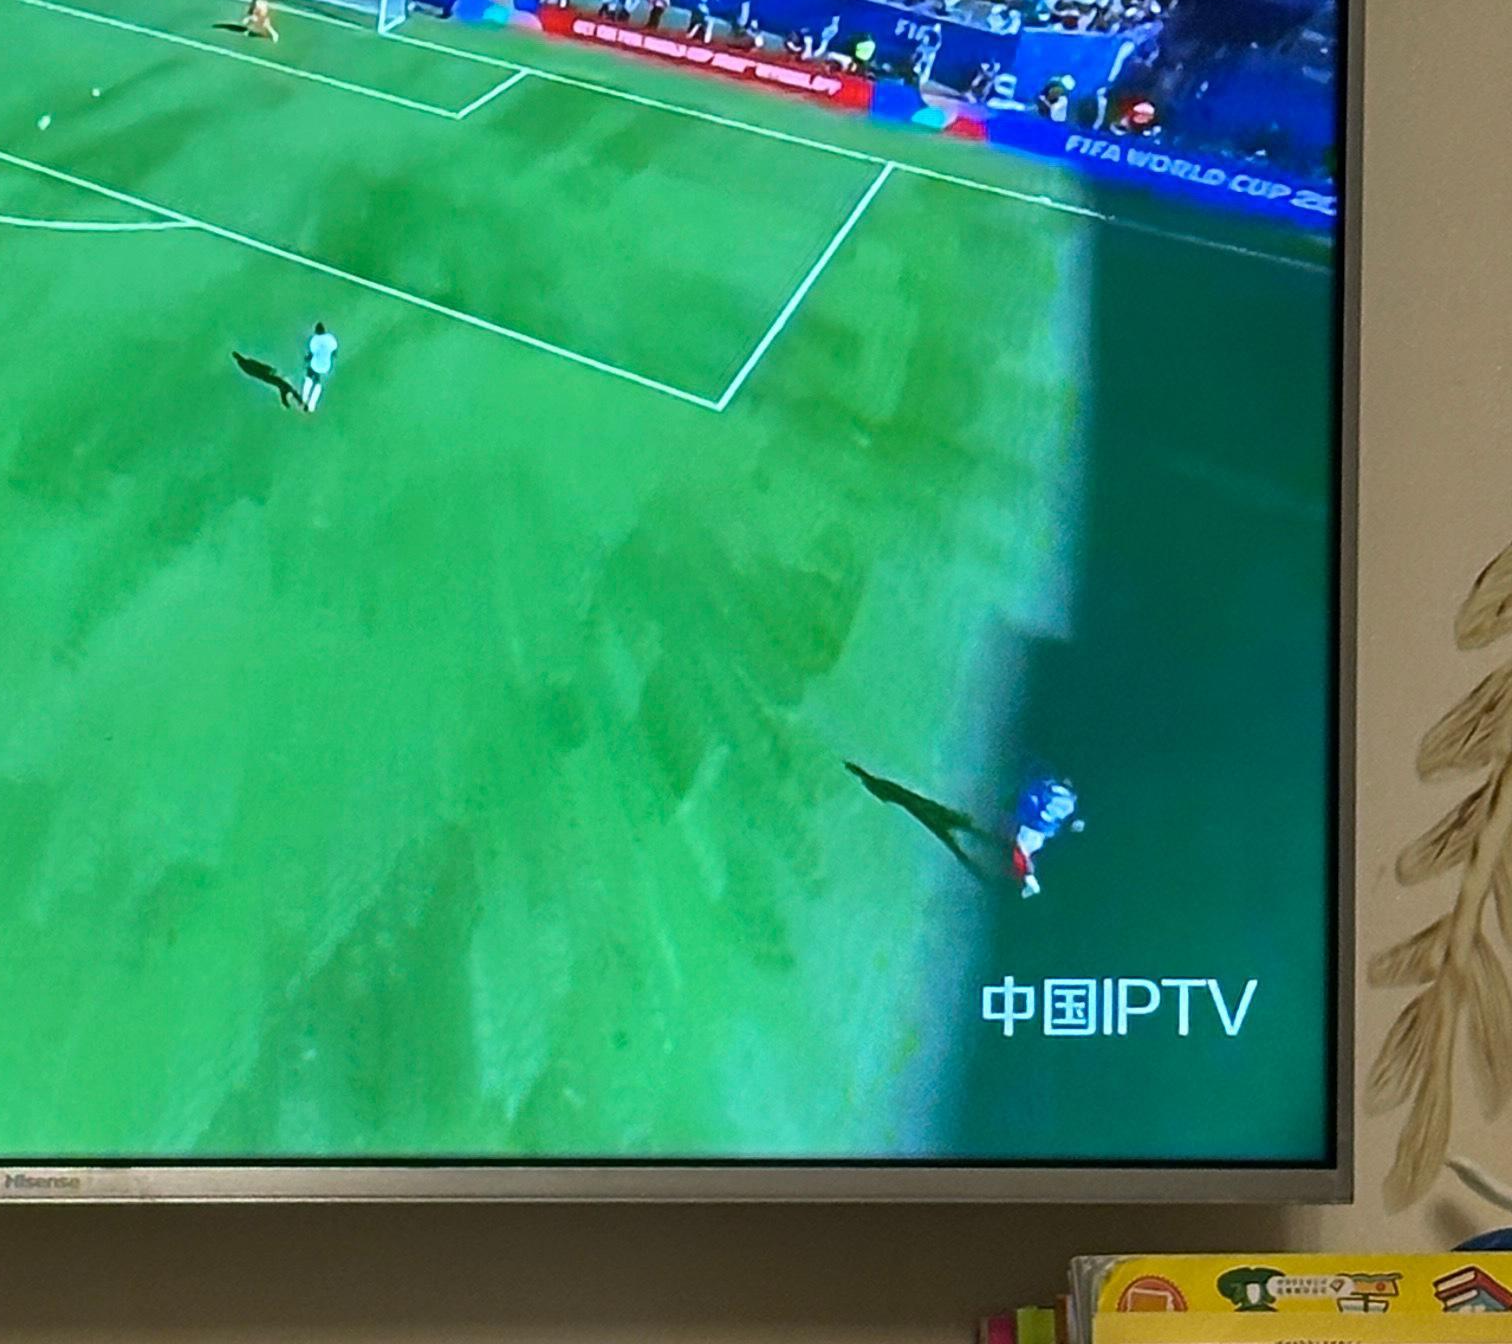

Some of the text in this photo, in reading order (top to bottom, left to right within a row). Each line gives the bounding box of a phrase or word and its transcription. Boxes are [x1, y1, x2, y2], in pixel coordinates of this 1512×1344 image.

[1064, 134, 1121, 163] FIFA
[1126, 147, 1227, 187] WORLD
[1228, 174, 1292, 200] CUP
[982, 975, 1259, 1037] 中国IPTV
[4, 1173, 81, 1189] Hisense
